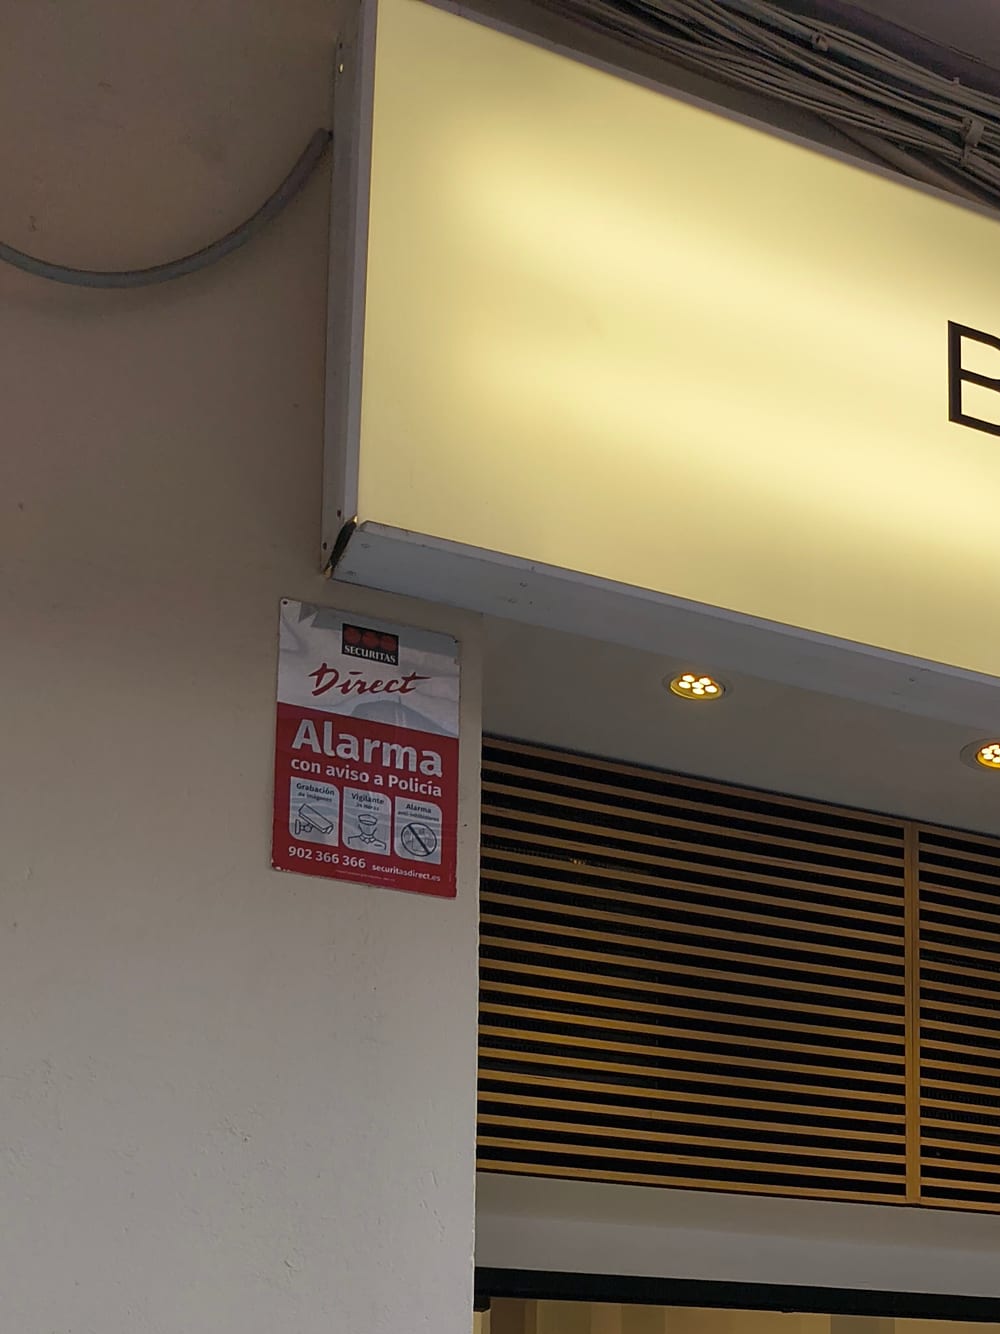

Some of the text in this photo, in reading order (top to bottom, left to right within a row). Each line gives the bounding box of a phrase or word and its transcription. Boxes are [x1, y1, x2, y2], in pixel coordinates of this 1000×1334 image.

[344, 644, 397, 664] SECURITAS
[309, 662, 433, 696] Direct
[291, 719, 444, 778] Alarma
[290, 758, 442, 797] con aviso a Policía
[296, 783, 335, 796] Grabación
[351, 792, 385, 805] Vigilante
[406, 803, 432, 814] Alarma
[289, 846, 366, 869] 902 366 366
[372, 863, 441, 882] securitasdirect.es
